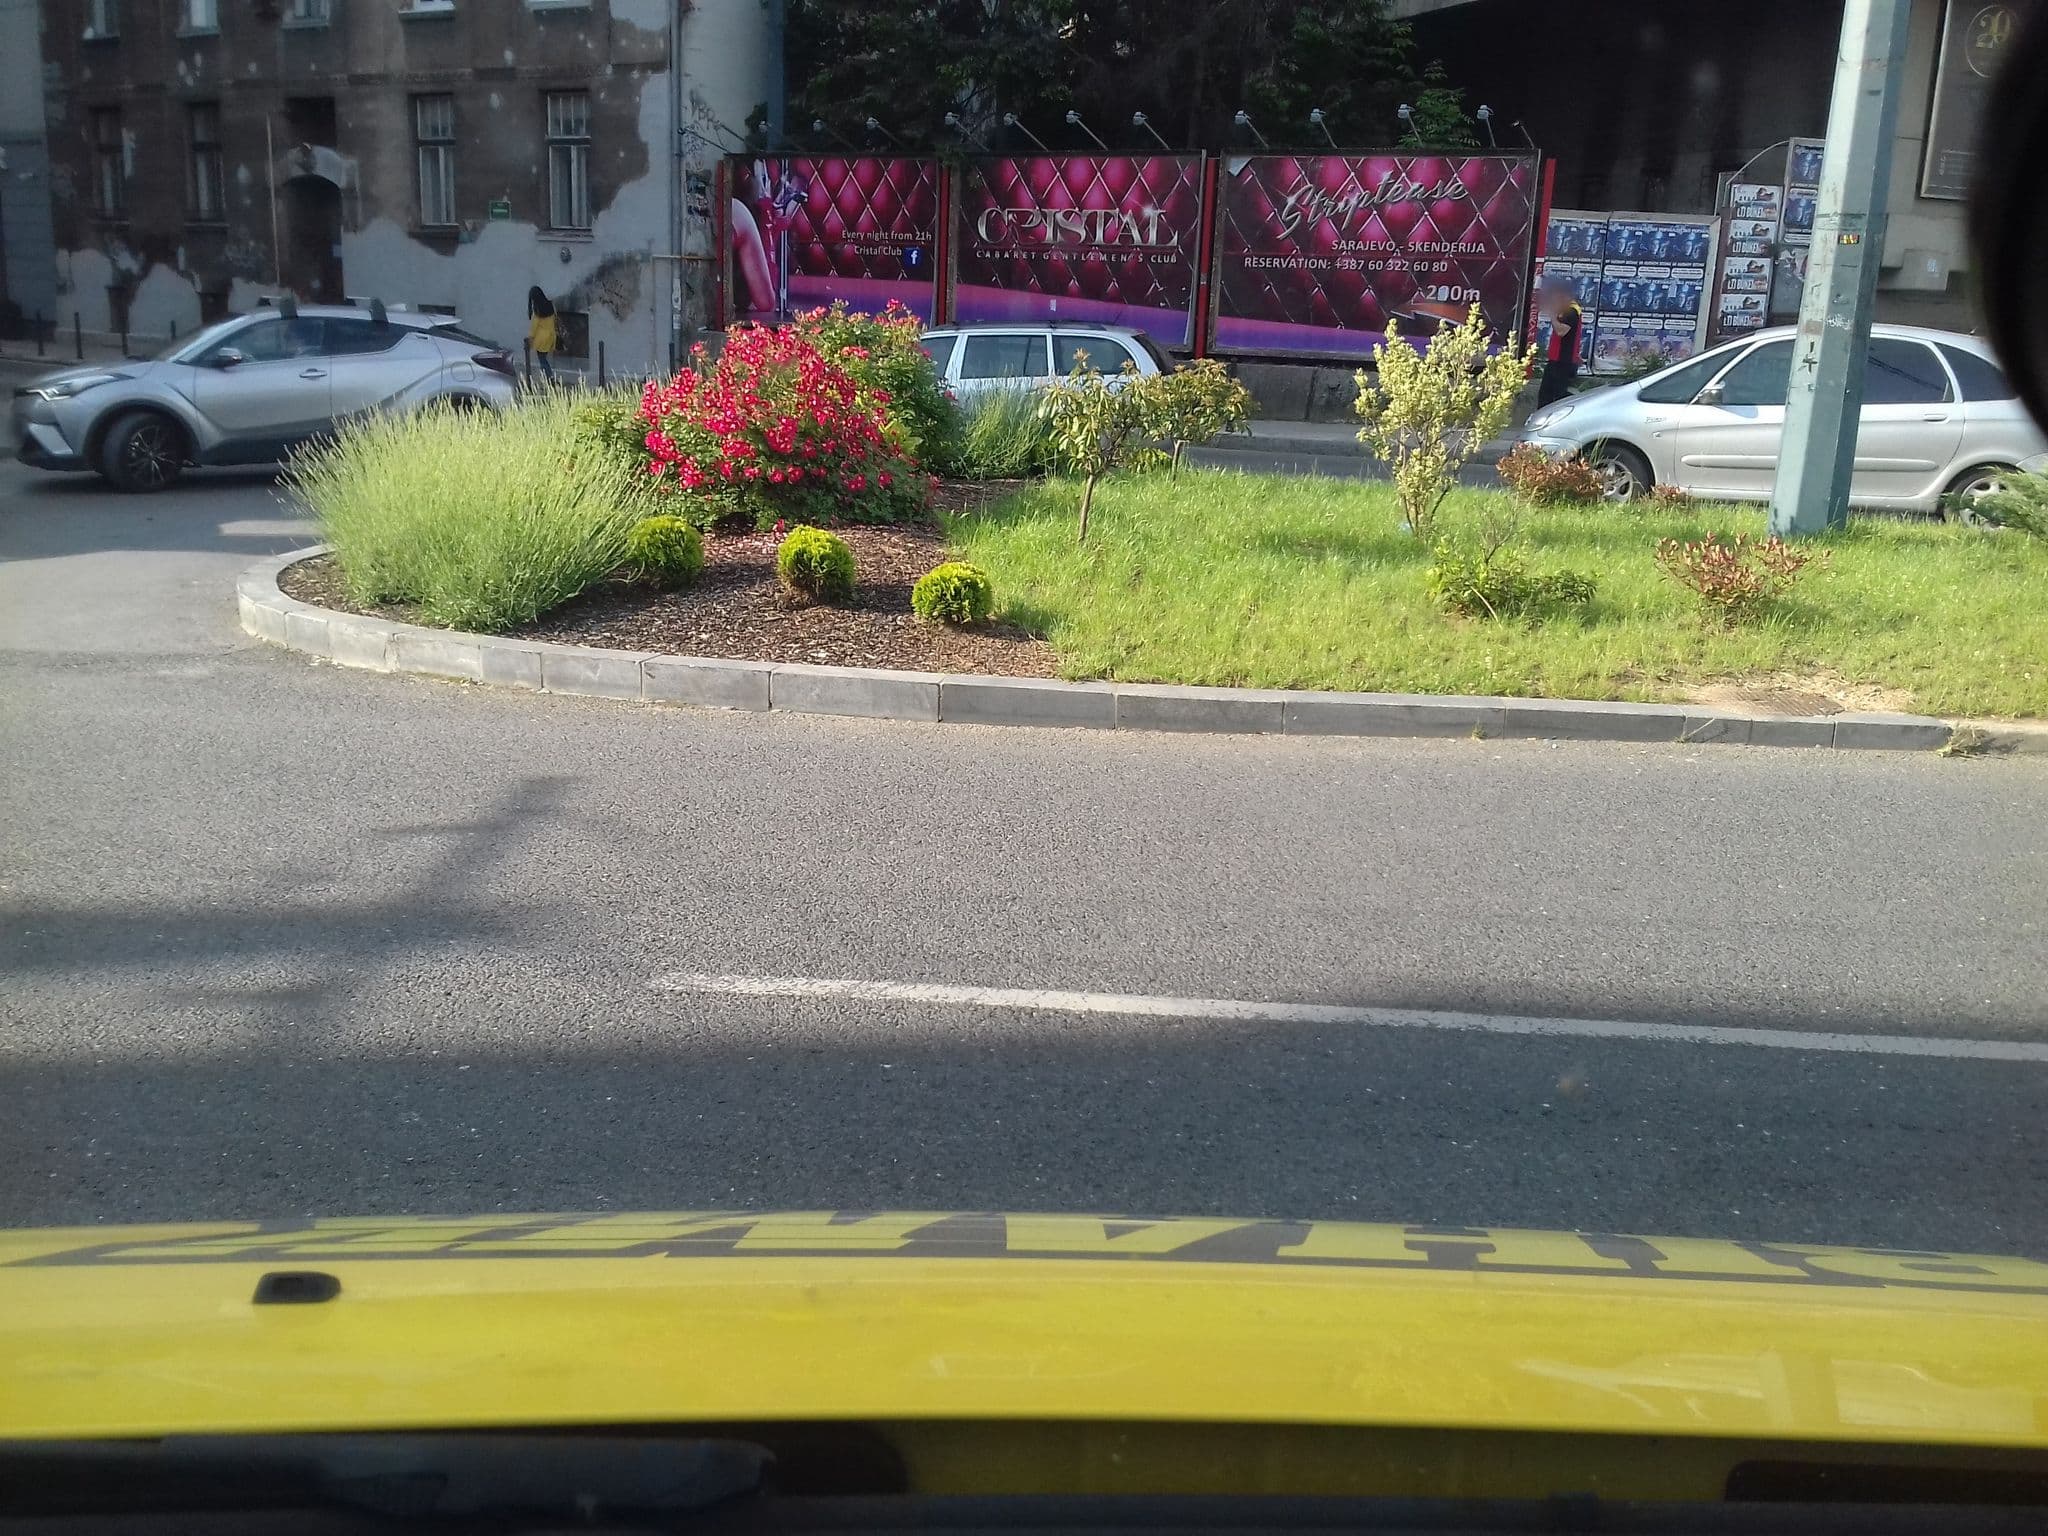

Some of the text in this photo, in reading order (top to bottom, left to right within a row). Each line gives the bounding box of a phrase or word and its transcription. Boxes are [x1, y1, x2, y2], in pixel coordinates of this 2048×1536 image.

[842, 230, 932, 241] Every night from 21h
[854, 245, 902, 256] Cristal Club
[1331, 240, 1396, 251] SARAJEVO
[1408, 241, 1486, 253] SKENDERIJA
[976, 251, 1036, 260] CABARET
[1150, 254, 1177, 263] CLUB
[1244, 257, 1448, 272] RESERVATION: +387 60 322 60 80
